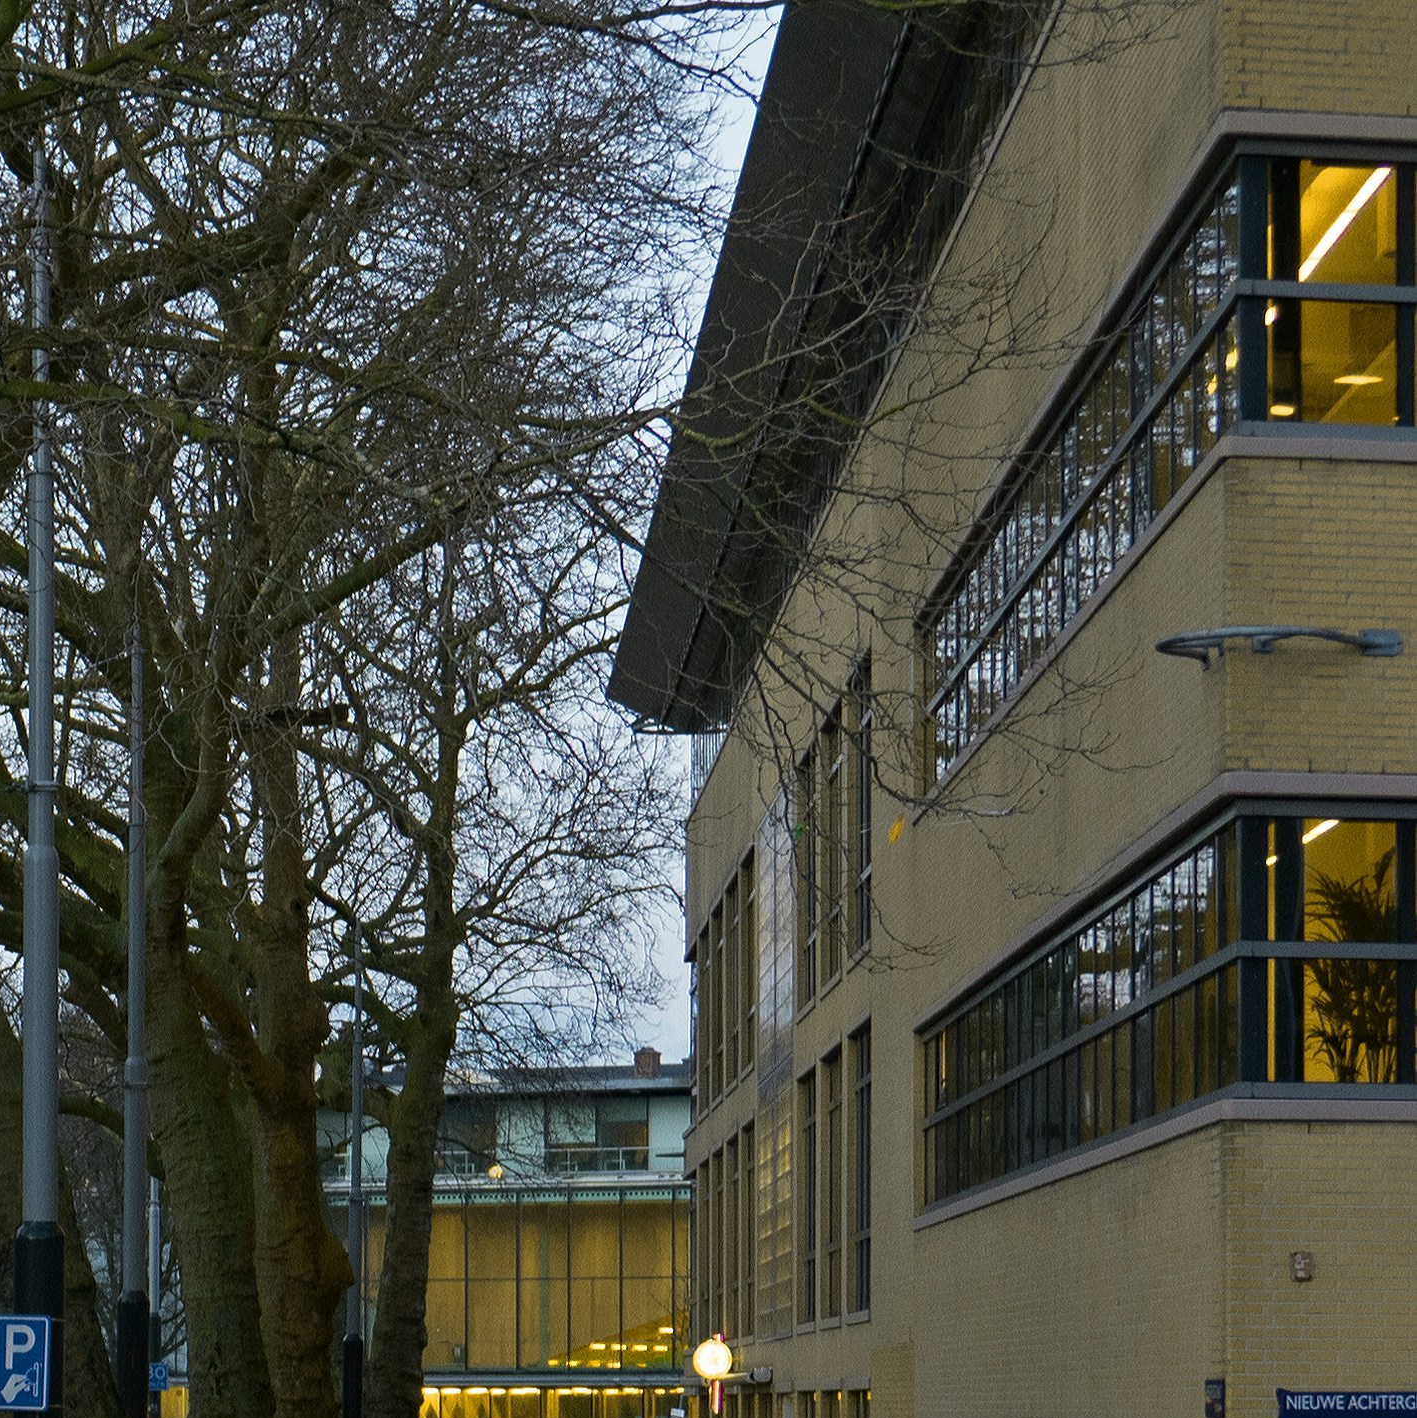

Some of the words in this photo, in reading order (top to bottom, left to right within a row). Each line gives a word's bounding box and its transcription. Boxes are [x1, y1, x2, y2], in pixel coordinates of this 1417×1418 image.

[5, 1324, 36, 1370] P
[1286, 1394, 1345, 1410] NIEUWE
[1347, 1394, 1417, 1410] ACHTERG
